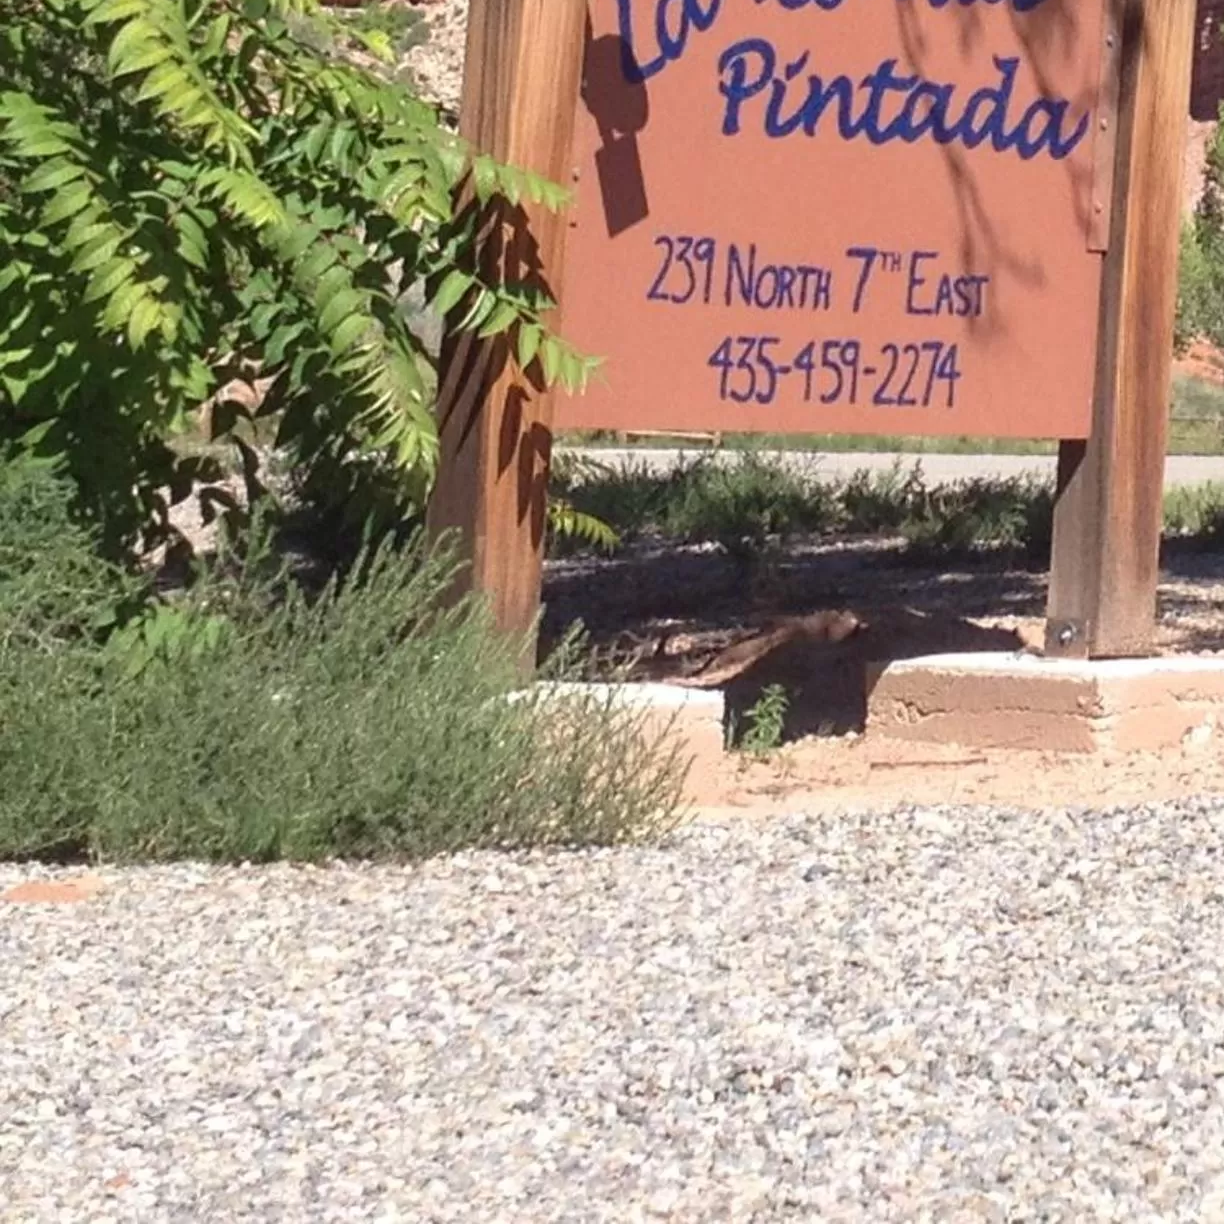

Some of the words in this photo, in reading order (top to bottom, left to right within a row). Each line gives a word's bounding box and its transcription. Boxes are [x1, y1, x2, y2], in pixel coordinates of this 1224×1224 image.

[647, 236, 716, 305] 239
[725, 244, 831, 309] NORTH
[906, 251, 989, 316] EAST
[708, 337, 960, 407] 435-459-2274
